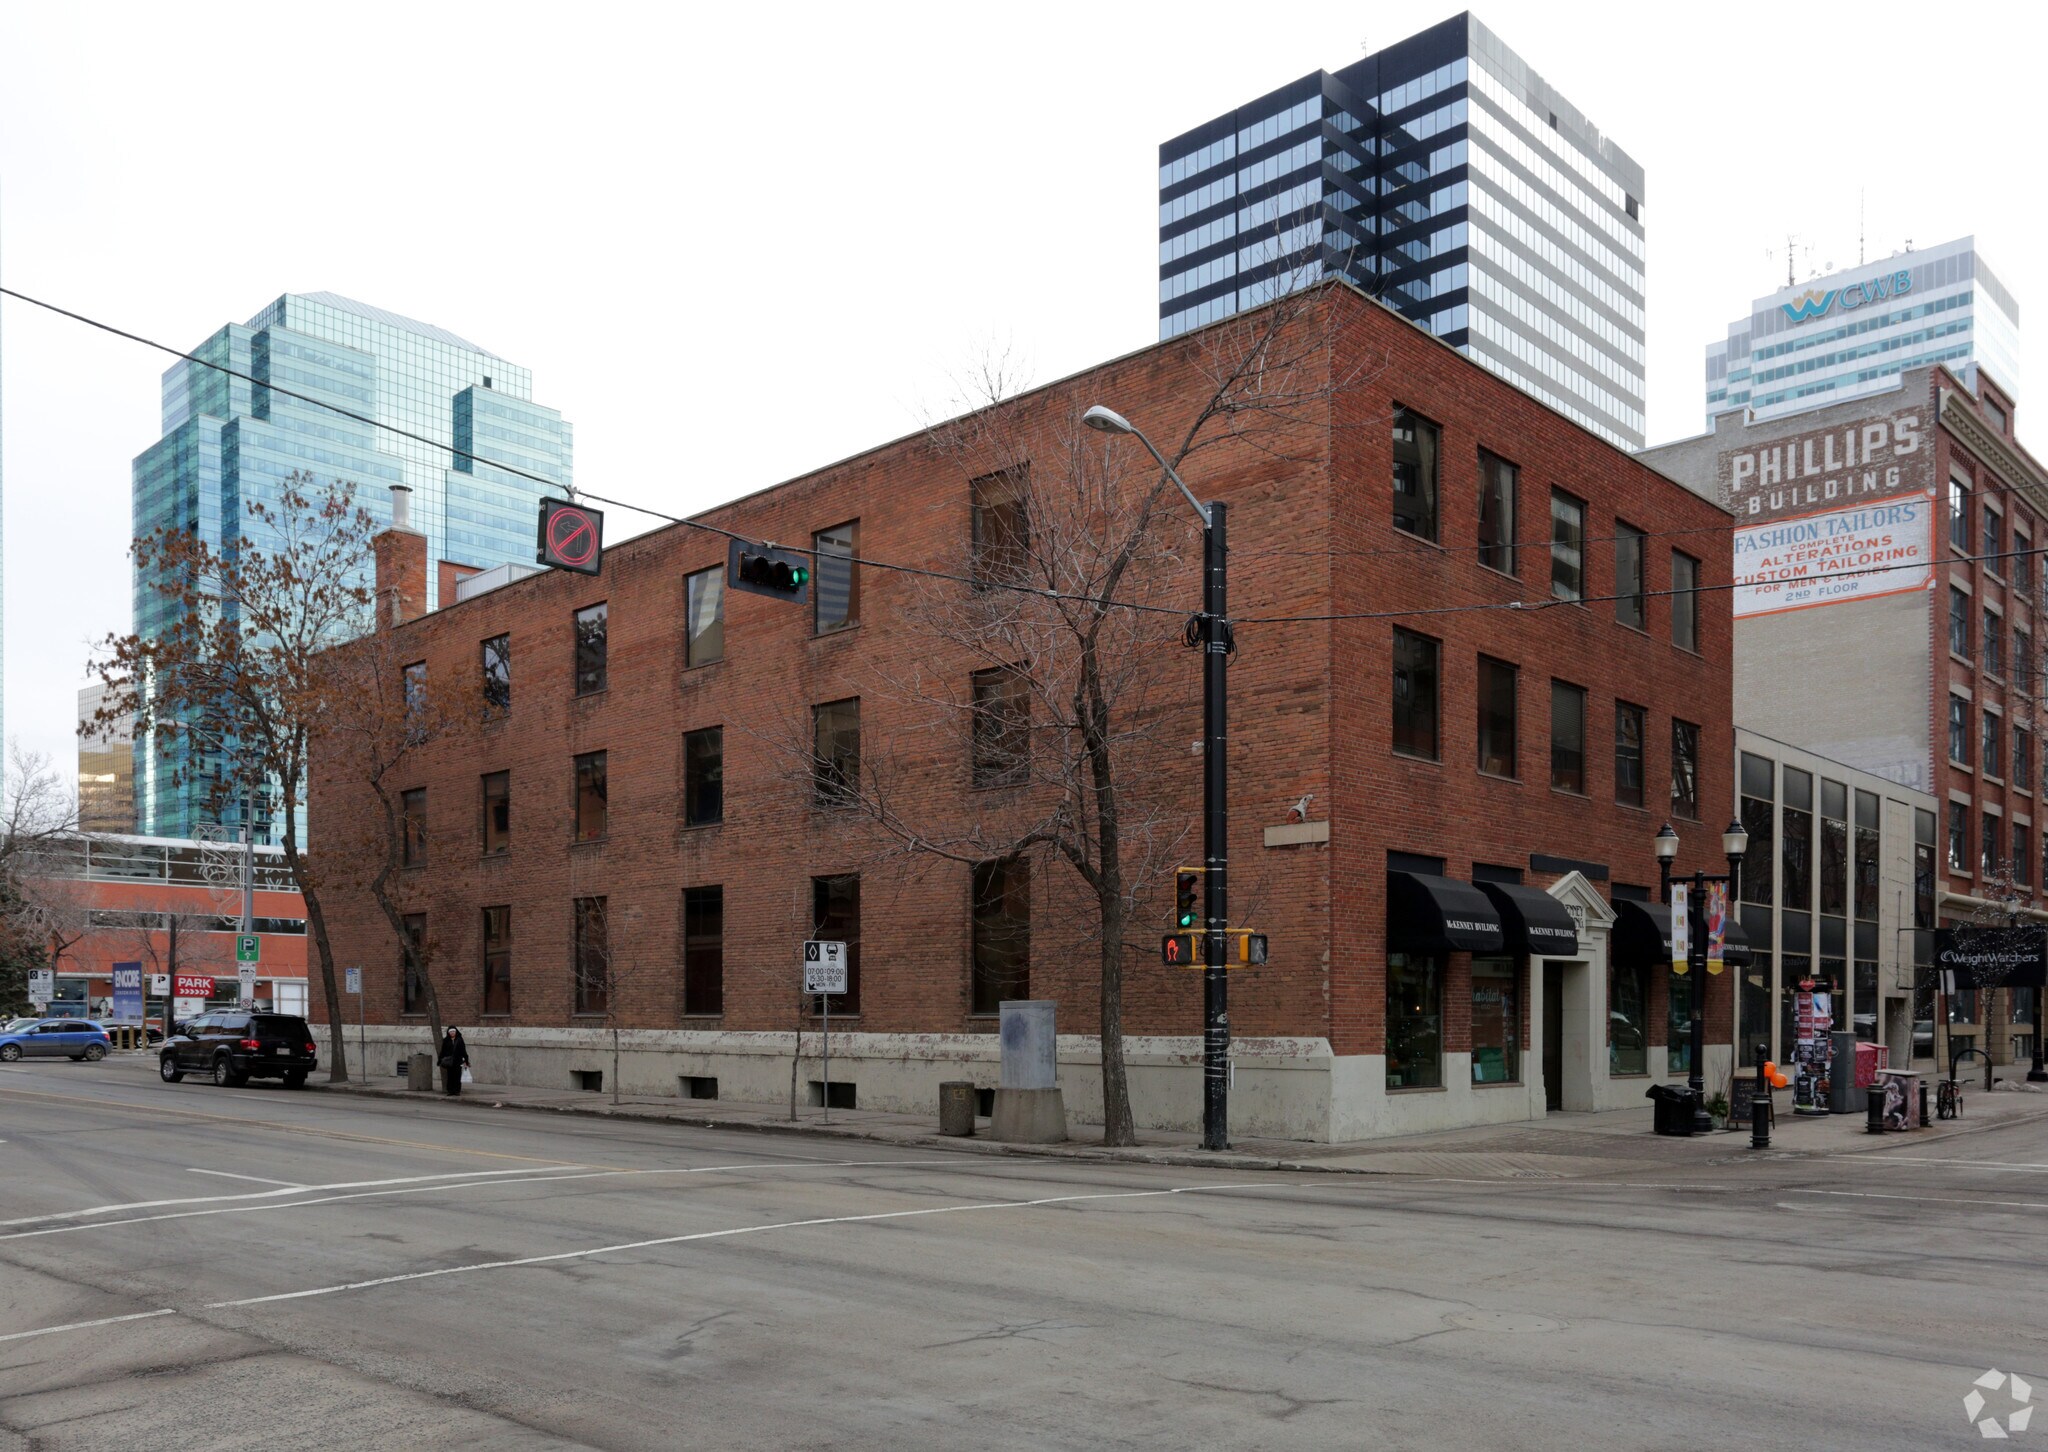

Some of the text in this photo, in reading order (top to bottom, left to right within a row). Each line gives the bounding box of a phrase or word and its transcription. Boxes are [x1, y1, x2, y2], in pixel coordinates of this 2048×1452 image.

[1840, 269, 1913, 309] CWB
[1732, 415, 1920, 492] PHILLIPS
[1748, 466, 1900, 515] BUILDING
[1734, 504, 1916, 555] FASHION TAILORS
[1790, 534, 1855, 552] COMPLETE
[1760, 534, 1893, 568] ALTERATIONS
[1734, 545, 1918, 585] CUSTOM TAILORING
[1755, 583, 1781, 596] FOR
[1788, 577, 1817, 590] MEN
[1785, 582, 1859, 602] 2ND FLOOR
[242, 939, 254, 950] P
[114, 969, 140, 988] ENCORE
[178, 977, 211, 989] PARK
